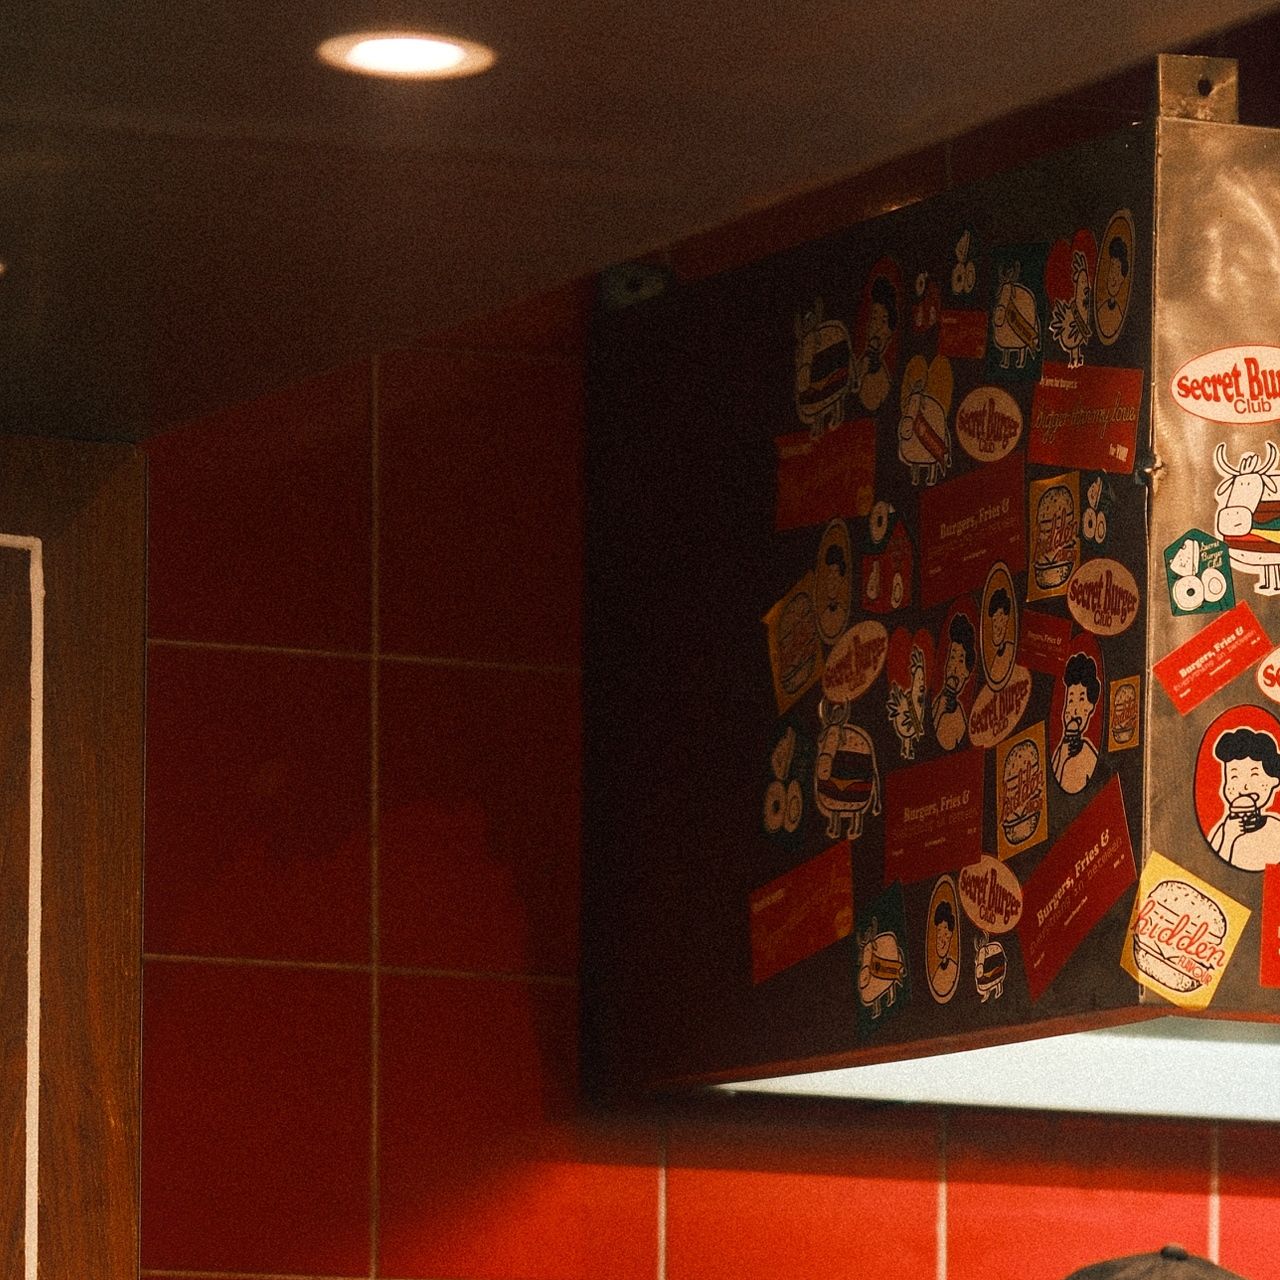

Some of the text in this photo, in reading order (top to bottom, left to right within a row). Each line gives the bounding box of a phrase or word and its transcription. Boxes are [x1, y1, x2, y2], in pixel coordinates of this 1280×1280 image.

[1233, 398, 1272, 414] Club
[1103, 569, 1137, 624] Burger
[1094, 609, 1112, 627] Club
[1213, 634, 1236, 652] Fries
[940, 794, 961, 812] Fries
[988, 867, 1021, 925] Burger
[1036, 876, 1075, 928] Burgers,
[1074, 843, 1100, 878] Fries
[1130, 900, 1225, 967] hidden
[1178, 955, 1213, 985] FLAVOUR
